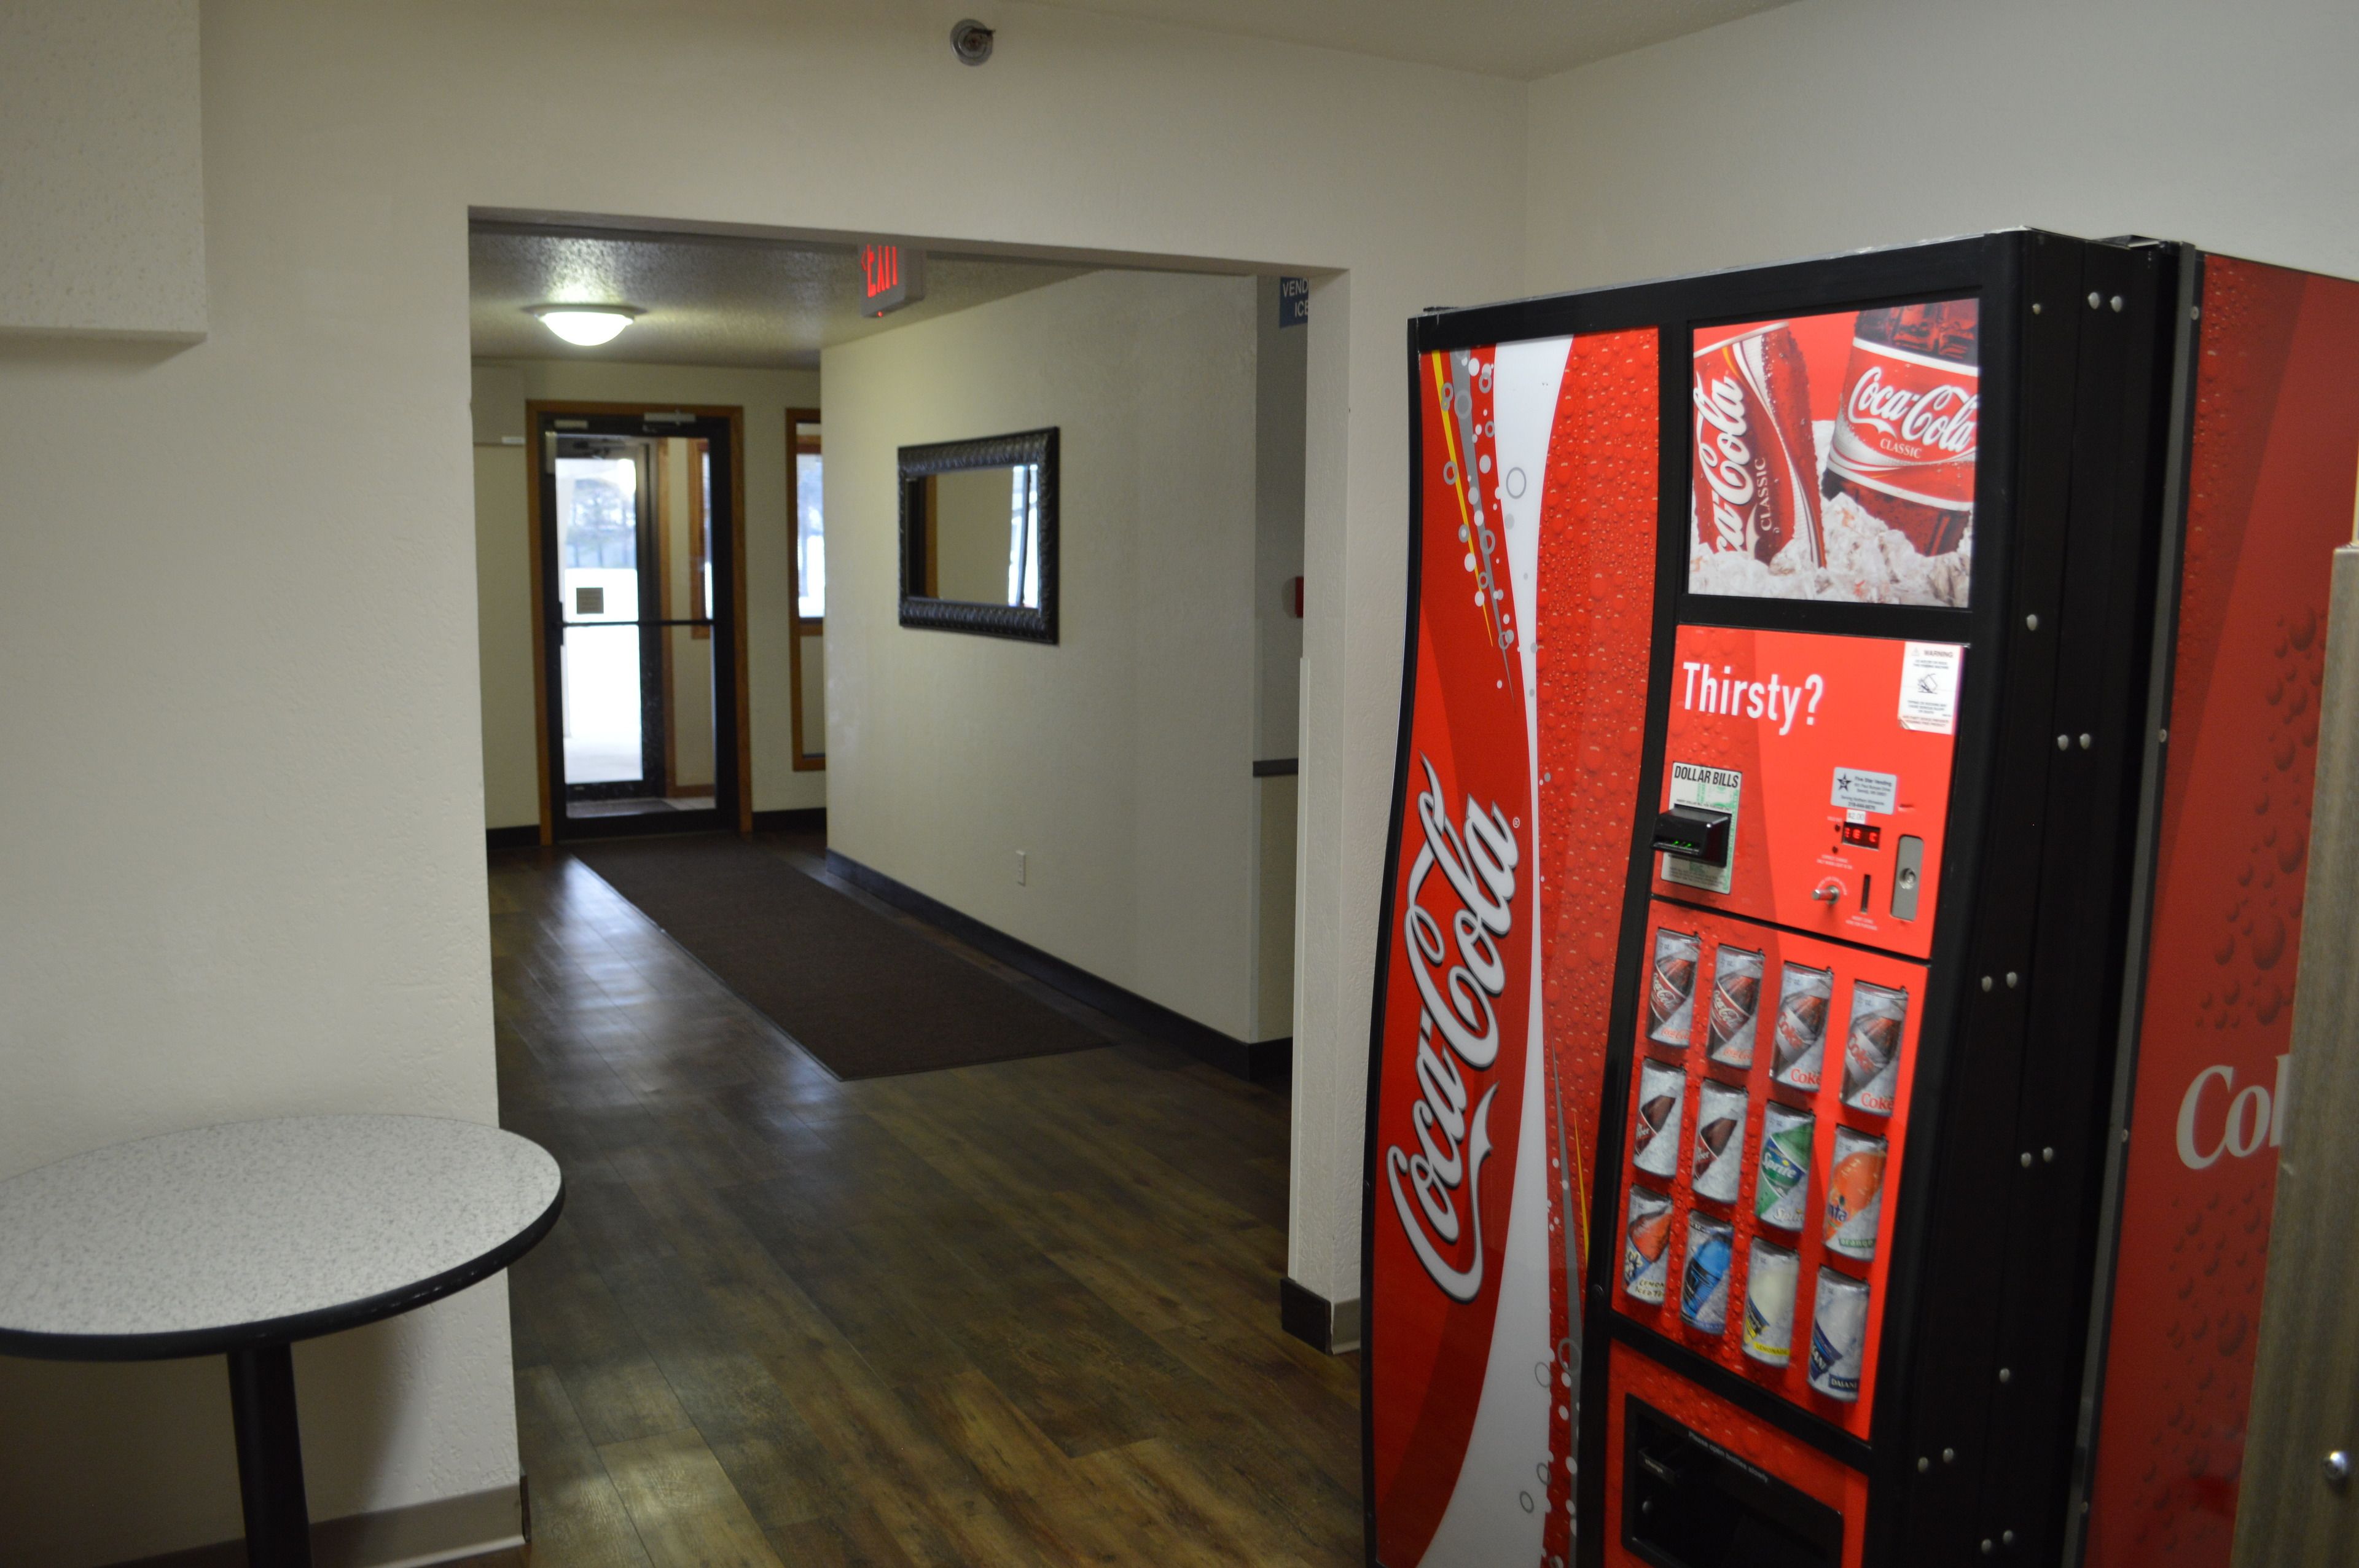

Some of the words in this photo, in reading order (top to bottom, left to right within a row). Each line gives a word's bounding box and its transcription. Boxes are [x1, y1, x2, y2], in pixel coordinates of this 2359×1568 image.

[1847, 367, 1978, 453] Coca-Cola
[1879, 437, 1923, 459] CLASSIC
[1755, 457, 1770, 532] CLASSIC
[1683, 661, 1824, 736] Thirsty?
[1674, 765, 1712, 784] DOLLAR
[1712, 771, 1739, 788] BILLS
[1387, 750, 1520, 1306] Coca-Cola
[1762, 1152, 1796, 1179] Sprite
